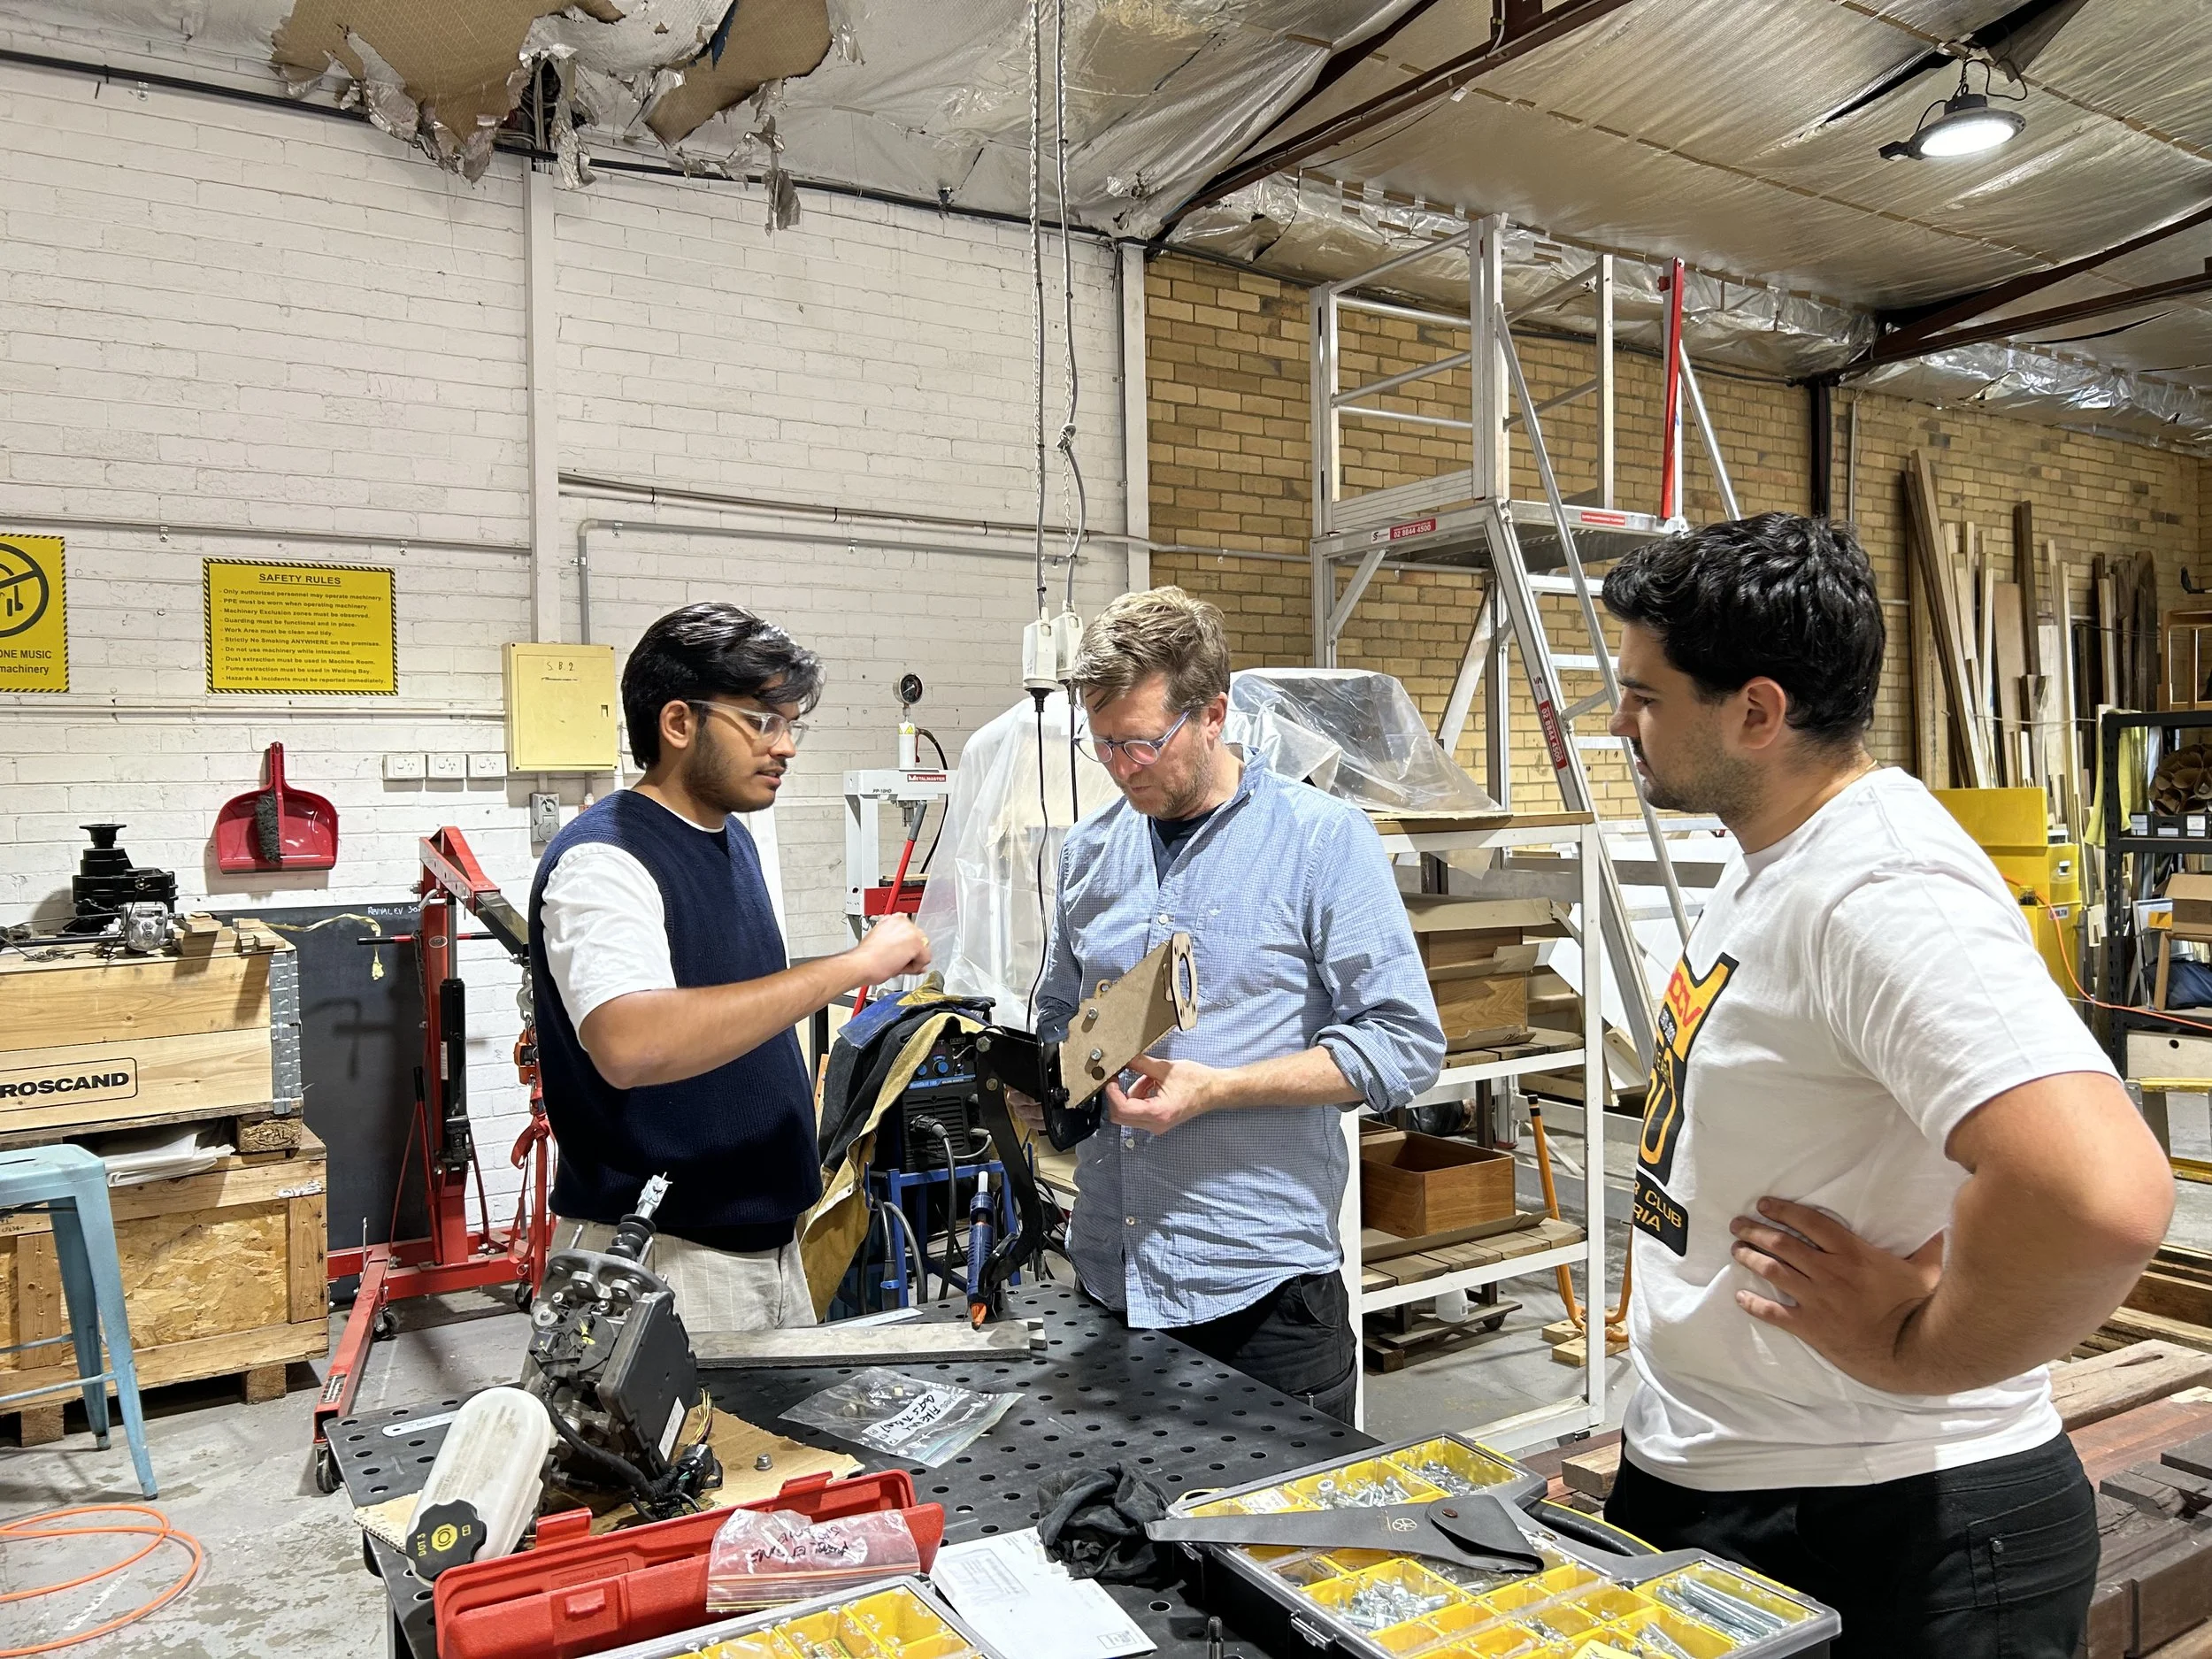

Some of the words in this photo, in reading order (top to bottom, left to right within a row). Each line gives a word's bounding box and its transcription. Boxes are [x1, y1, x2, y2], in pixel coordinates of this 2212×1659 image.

[259, 573, 301, 583] SAFETY
[305, 575, 341, 585] RULES
[20, 650, 52, 659] MUSIC
[0, 664, 49, 676] machinery
[0, 1072, 129, 1098] ROSCAND
[1633, 1202, 1660, 1232] RIA
[1644, 1190, 1682, 1228] CLUB
[417, 1541, 426, 1557] DOT
